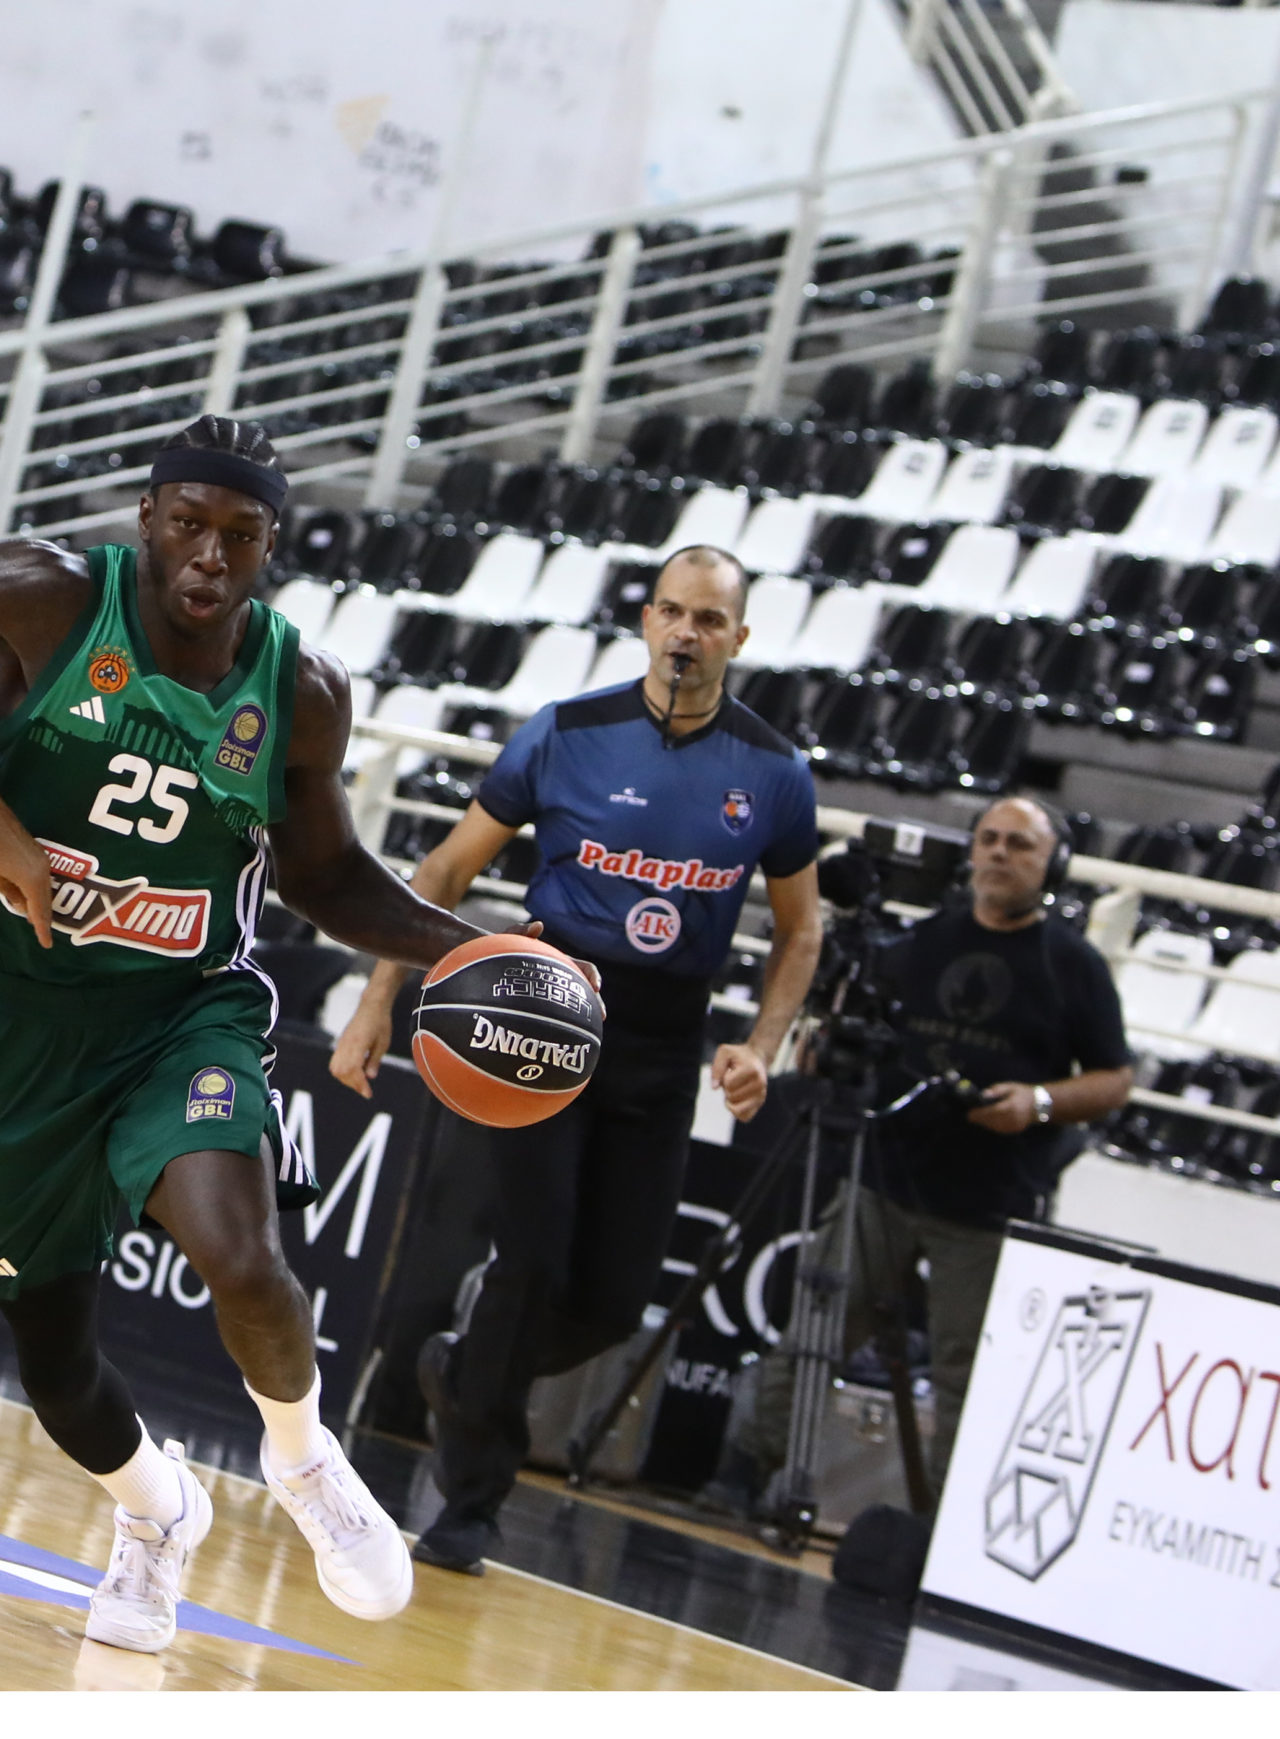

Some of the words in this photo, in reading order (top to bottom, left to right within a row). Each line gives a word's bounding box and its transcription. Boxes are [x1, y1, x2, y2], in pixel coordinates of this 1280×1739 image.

[217, 748, 250, 772] GBL
[88, 753, 200, 844] 25
[44, 848, 87, 877] ame
[578, 840, 745, 891] Palaplast
[492, 977, 592, 1022] LEGACY
[469, 1014, 591, 1074] SPALDING
[190, 1104, 228, 1118] GBL
[1108, 1499, 1266, 1584] ΕΥΚΑΜΠΤΗ
